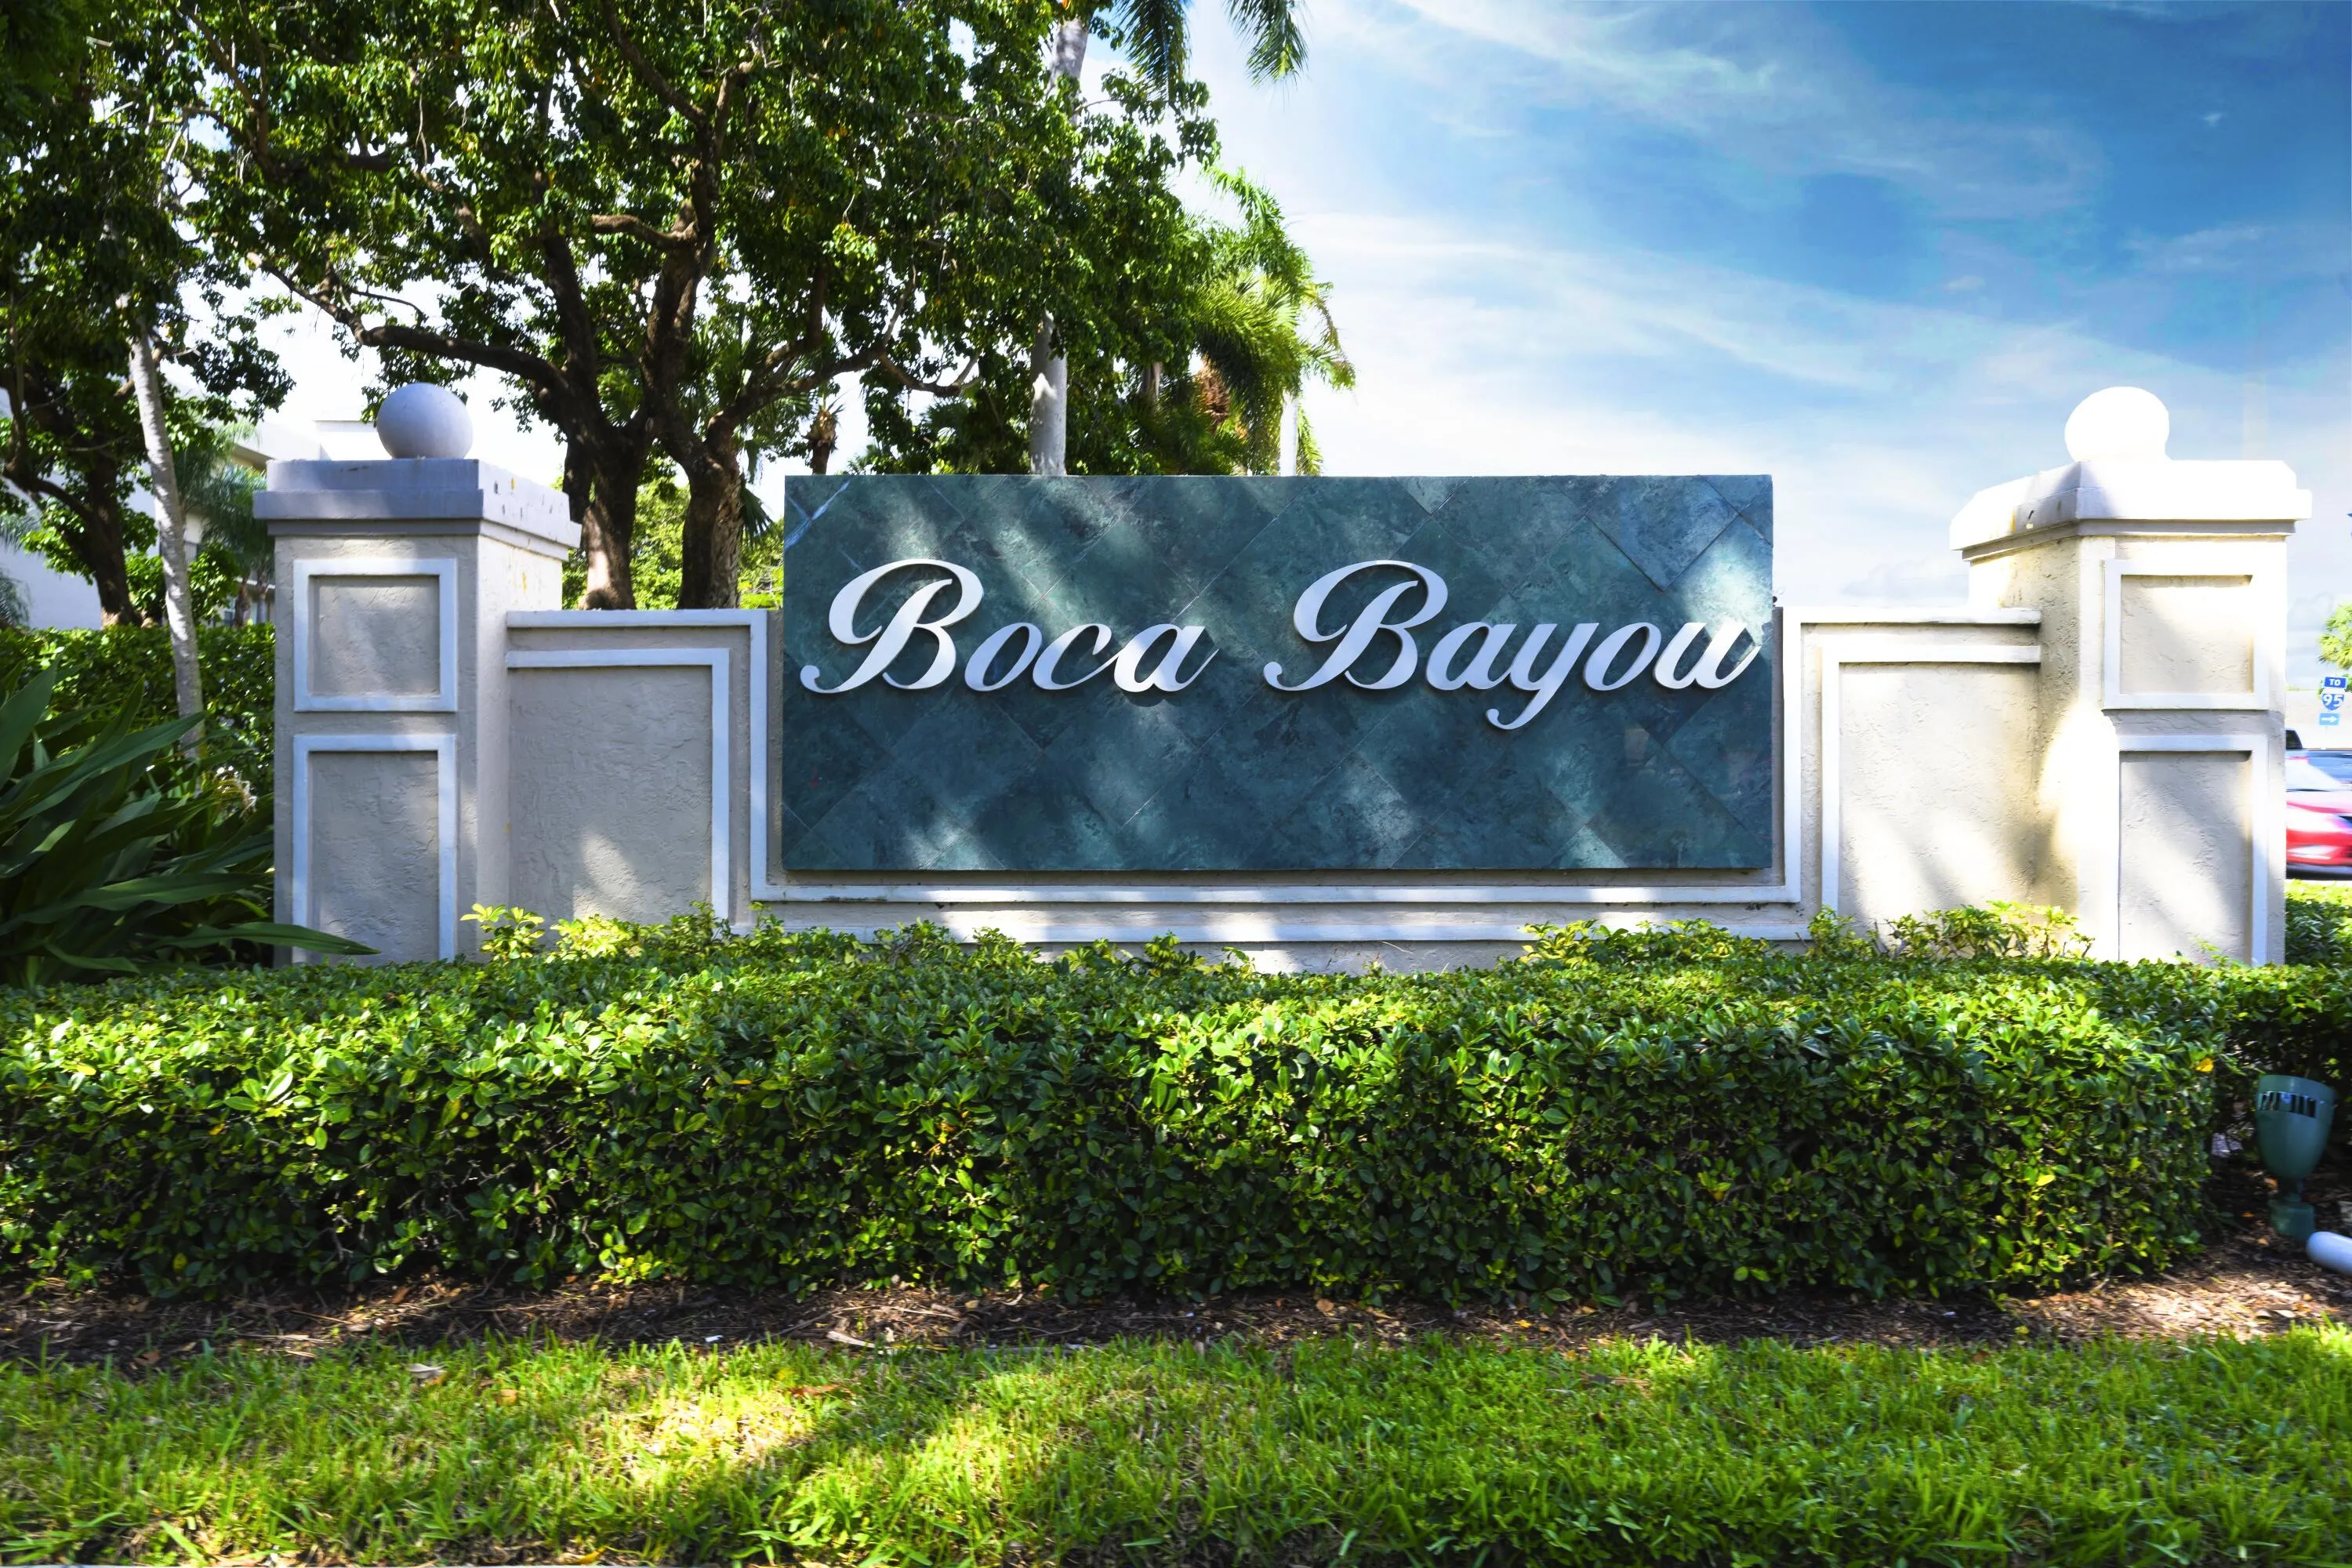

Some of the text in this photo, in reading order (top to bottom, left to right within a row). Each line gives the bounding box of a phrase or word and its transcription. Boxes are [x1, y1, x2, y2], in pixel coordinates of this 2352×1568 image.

[800, 558, 1764, 730] Boca Bayou
[2323, 694, 2343, 707] 95
